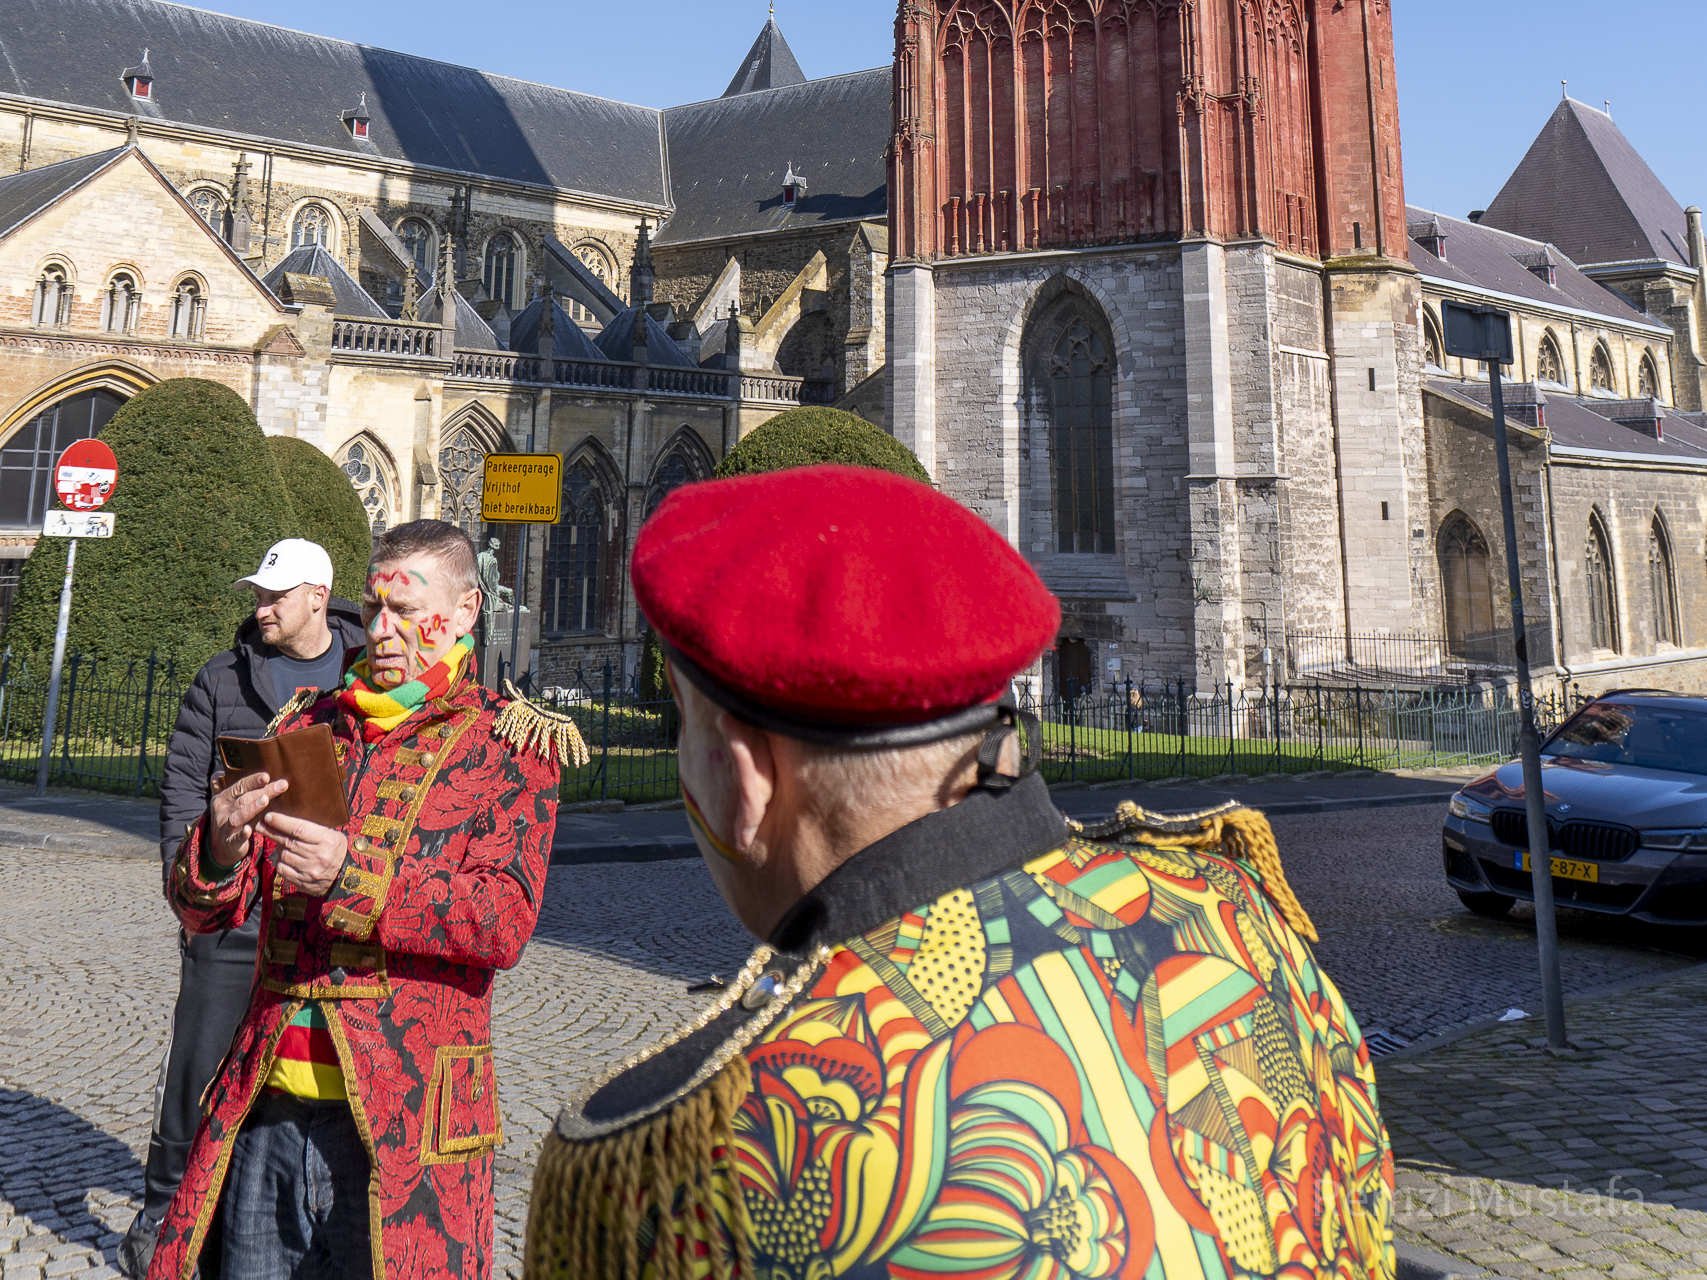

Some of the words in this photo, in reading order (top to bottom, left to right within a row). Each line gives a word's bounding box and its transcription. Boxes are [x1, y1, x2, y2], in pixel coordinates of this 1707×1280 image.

[486, 461, 554, 477] Parkeergarage
[485, 482, 521, 496] Vrijthof
[484, 502, 502, 513] niet
[505, 502, 555, 515] bereikbaar
